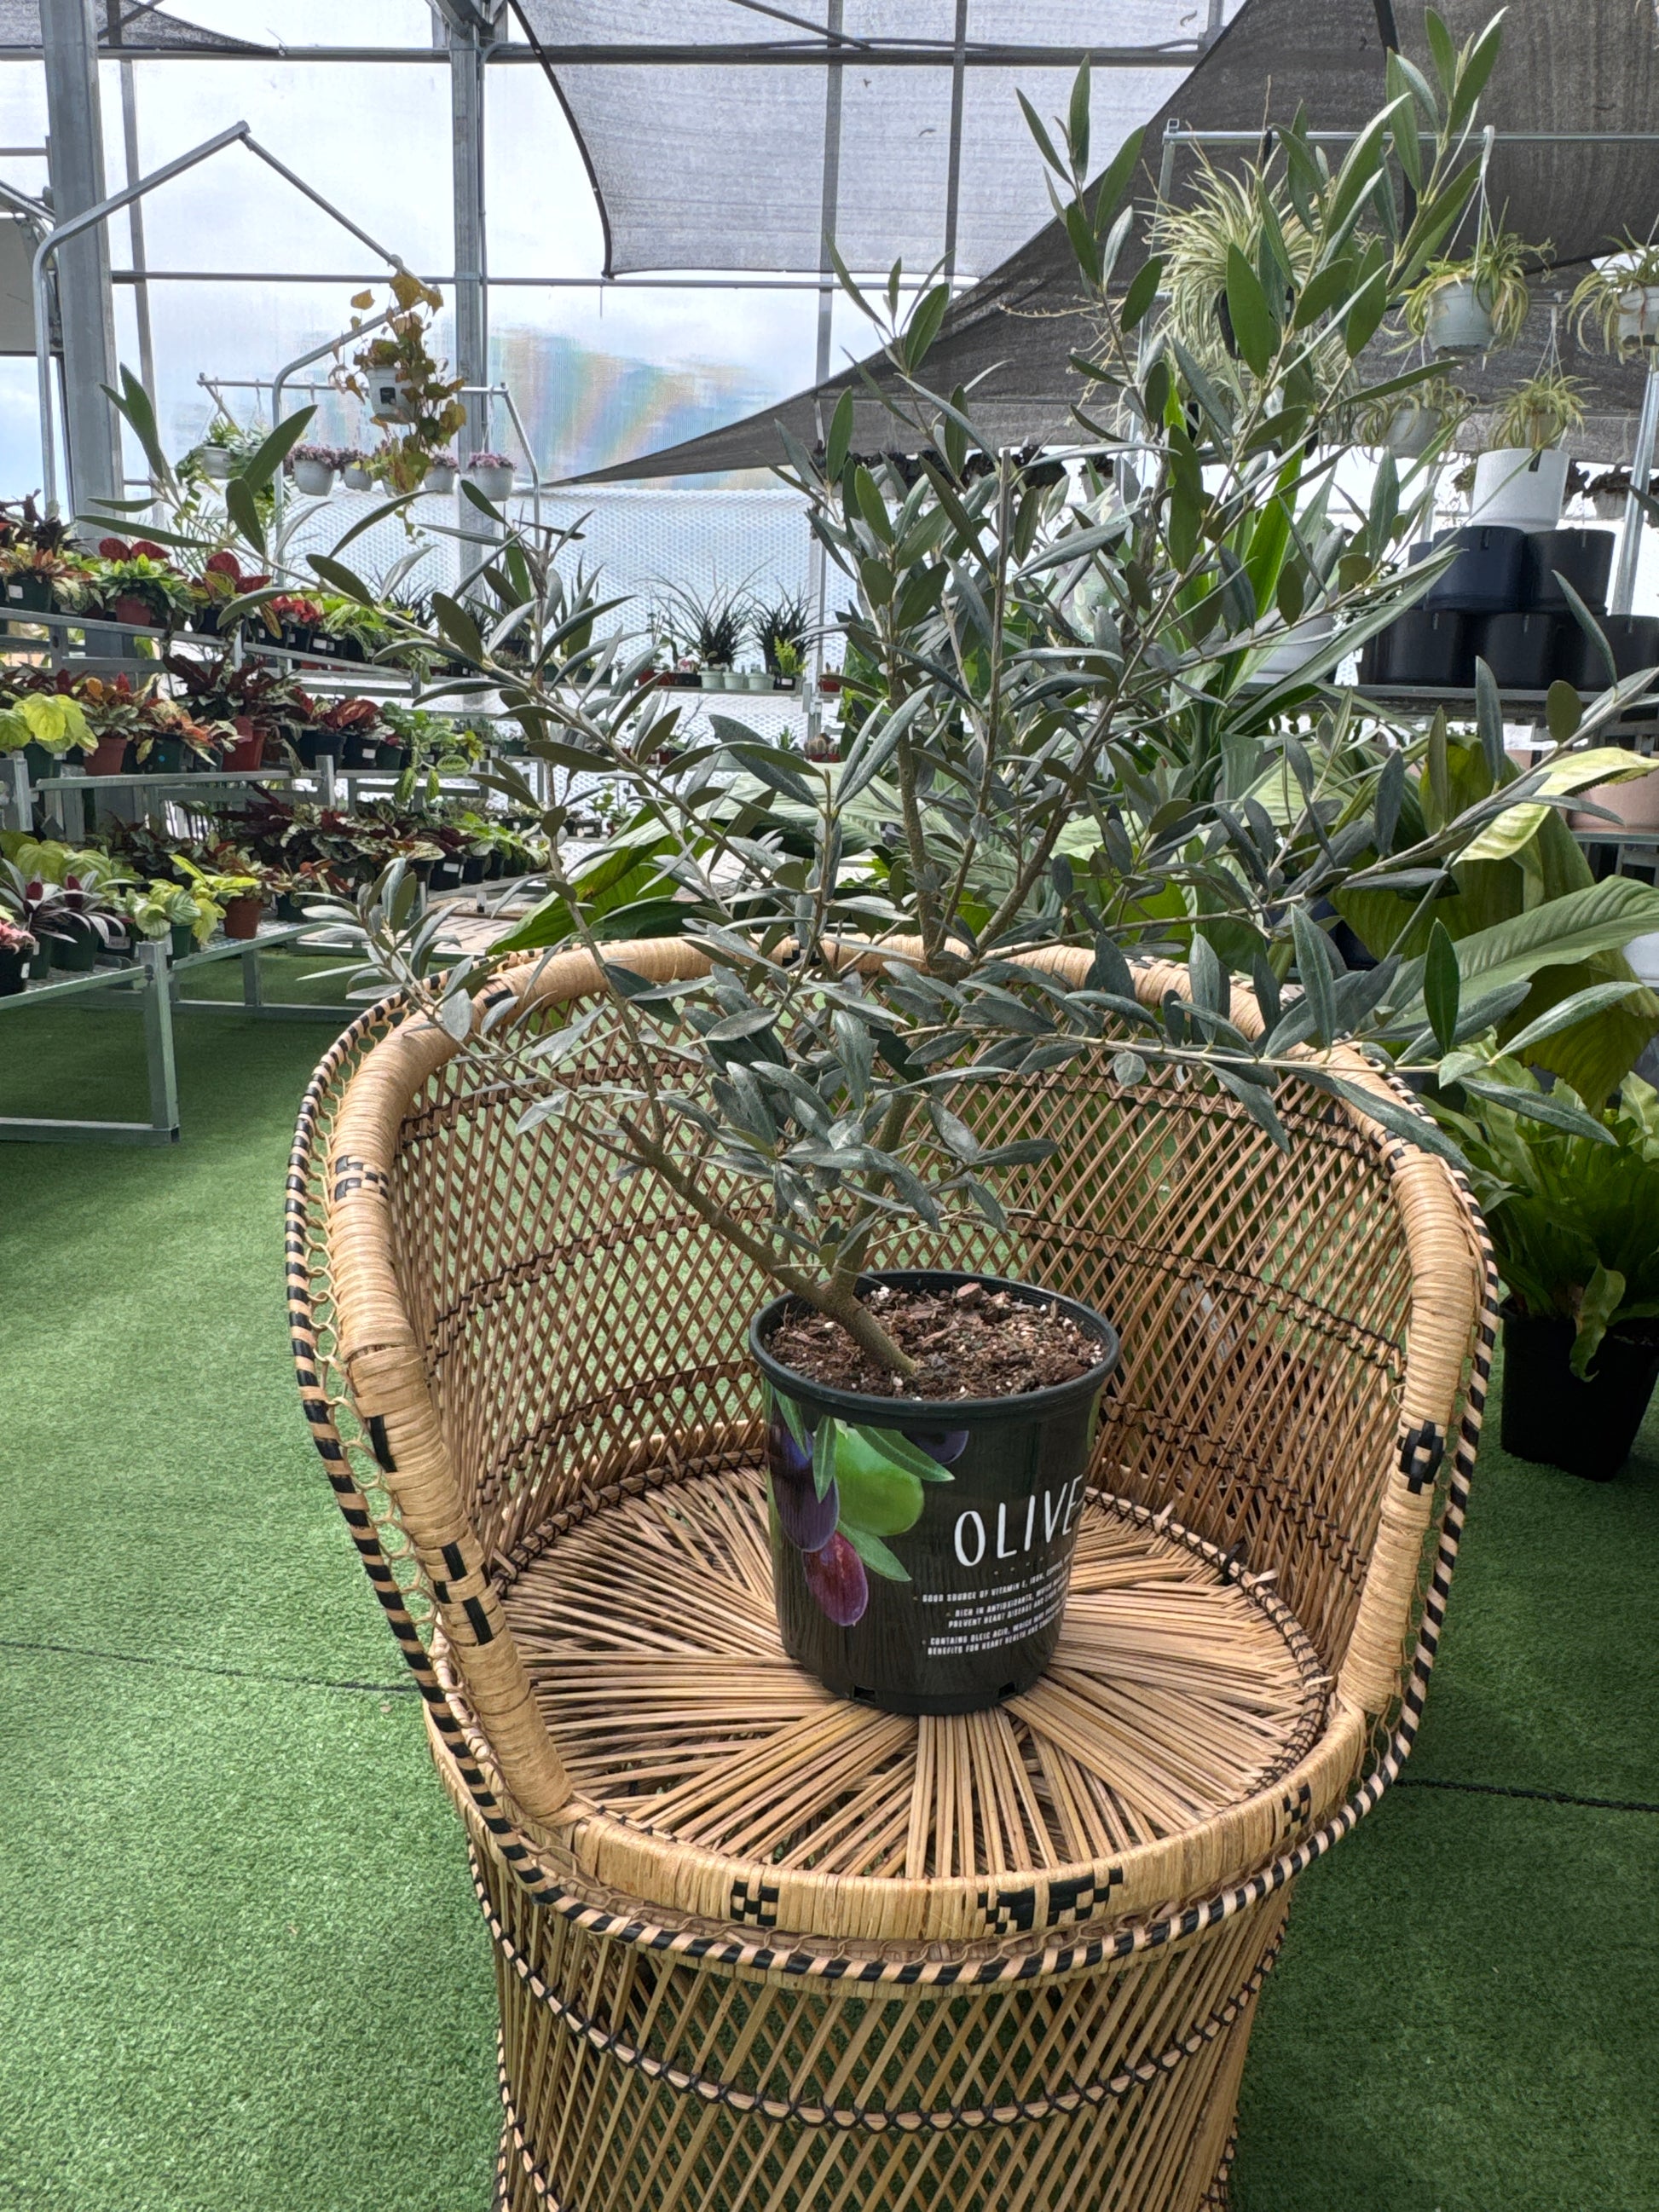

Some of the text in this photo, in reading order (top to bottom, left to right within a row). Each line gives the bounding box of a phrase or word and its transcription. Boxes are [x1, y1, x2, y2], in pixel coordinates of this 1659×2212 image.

[946, 1591, 976, 1603] SOURCE
[979, 1589, 989, 1599] OF
[991, 1582, 1020, 1597] VITAMIN
[948, 1617, 982, 1629] PREVENT
[984, 1612, 1006, 1625] HEART
[1007, 1603, 1032, 1620] DISEASE
[955, 1608, 974, 1618] RICH
[975, 1607, 985, 1615] IN
[928, 1645, 963, 1655] BENEFITS
[965, 1643, 980, 1654] FOR
[981, 1638, 1003, 1650] HEART
[1004, 1630, 1026, 1644] HEALTH
[930, 1635, 968, 1646] CONTAINS
[970, 1632, 991, 1643] OLEIC
